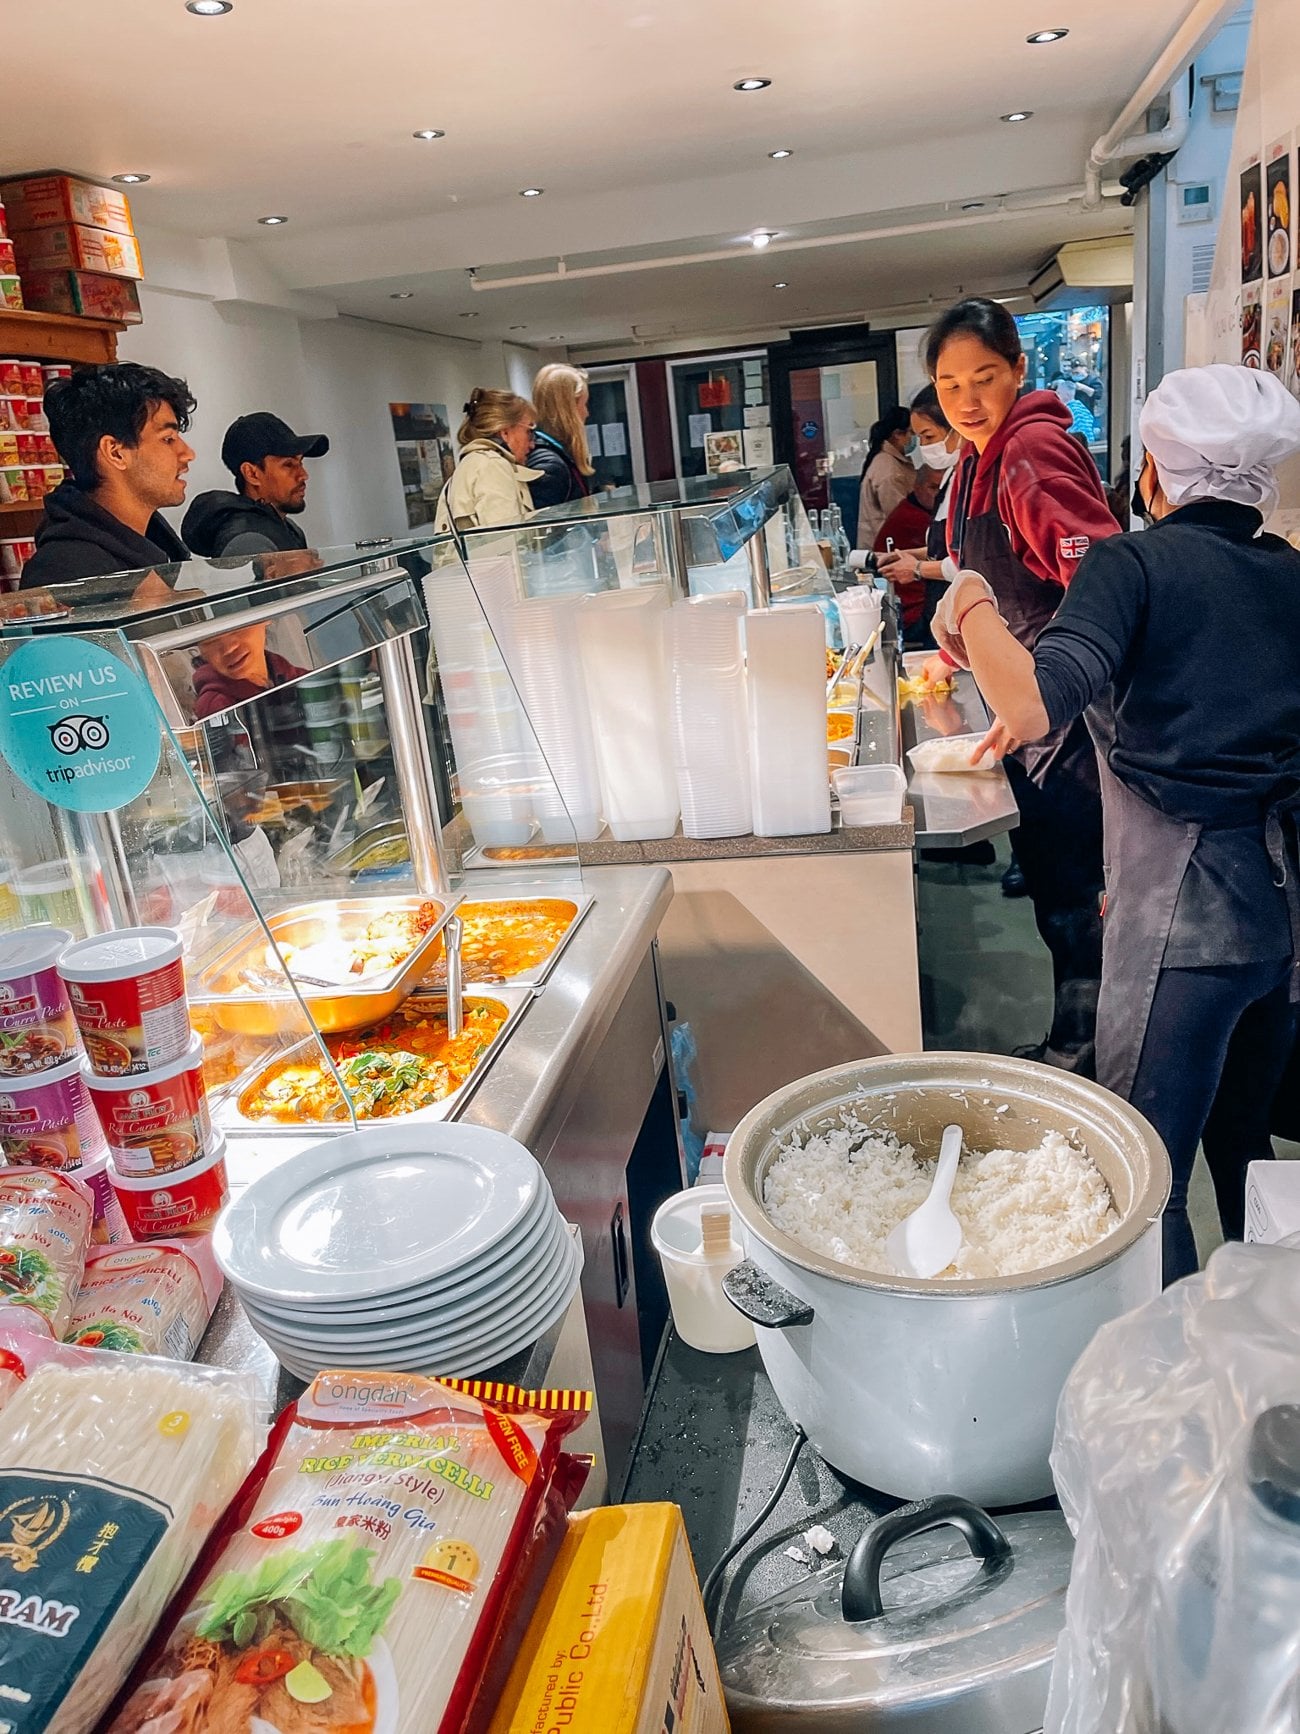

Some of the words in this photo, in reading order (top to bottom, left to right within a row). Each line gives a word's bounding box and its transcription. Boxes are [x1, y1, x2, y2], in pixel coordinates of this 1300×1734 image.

[8, 671, 83, 701] REVIEW
[88, 665, 117, 686] US
[59, 697, 79, 710] ON
[46, 757, 132, 784] tripadvisor
[41, 1003, 66, 1019] Paste
[98, 1018, 127, 1029] Paste
[41, 1116, 69, 1132] Paste
[129, 1121, 160, 1133] Curry
[168, 1415, 183, 1428] 3
[352, 1434, 461, 1452] IMPERIAL
[507, 1435, 530, 1470] FREE
[299, 1454, 355, 1474] RICE
[358, 1451, 496, 1500] VERMICELLI
[393, 1472, 446, 1505] Style)
[346, 1491, 402, 1518] Hoàng
[403, 1507, 437, 1531] Gia
[261, 1524, 286, 1537] 400g
[447, 1554, 457, 1571] 1
[550, 1650, 568, 1669] by:
